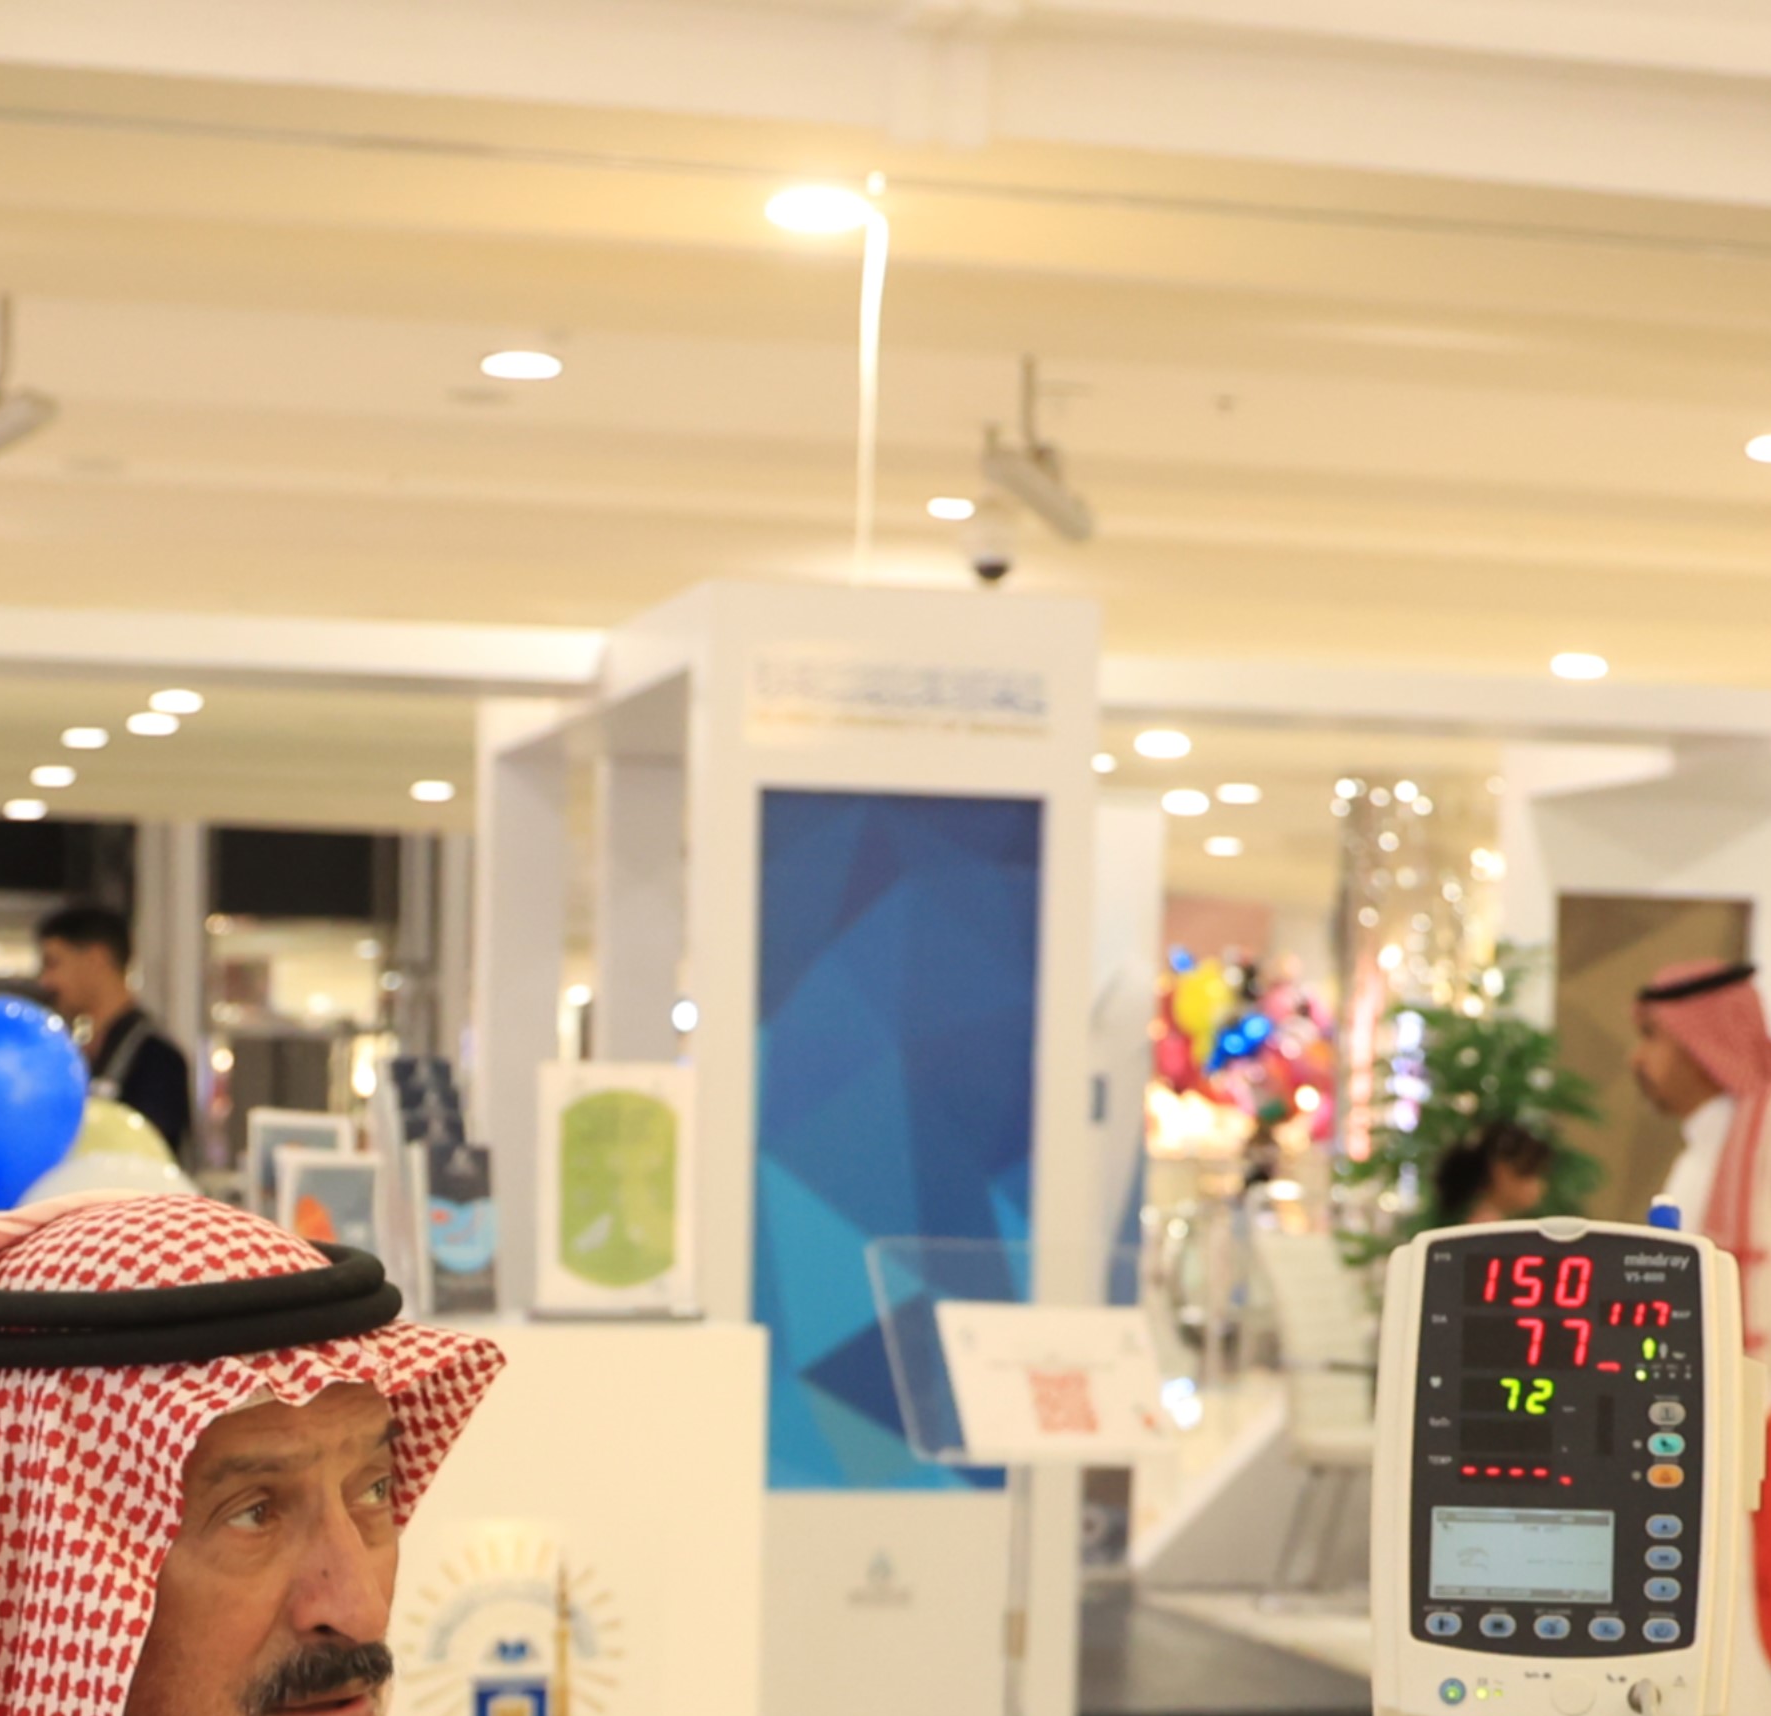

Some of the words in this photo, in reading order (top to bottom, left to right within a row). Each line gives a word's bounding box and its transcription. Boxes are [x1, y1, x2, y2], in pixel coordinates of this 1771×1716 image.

[1624, 1253, 1689, 1270] mindray
[1483, 1256, 1593, 1308] 150
[1609, 1302, 1671, 1326] 117
[1515, 1318, 1592, 1366] 77
[1500, 1378, 1554, 1415] 72
